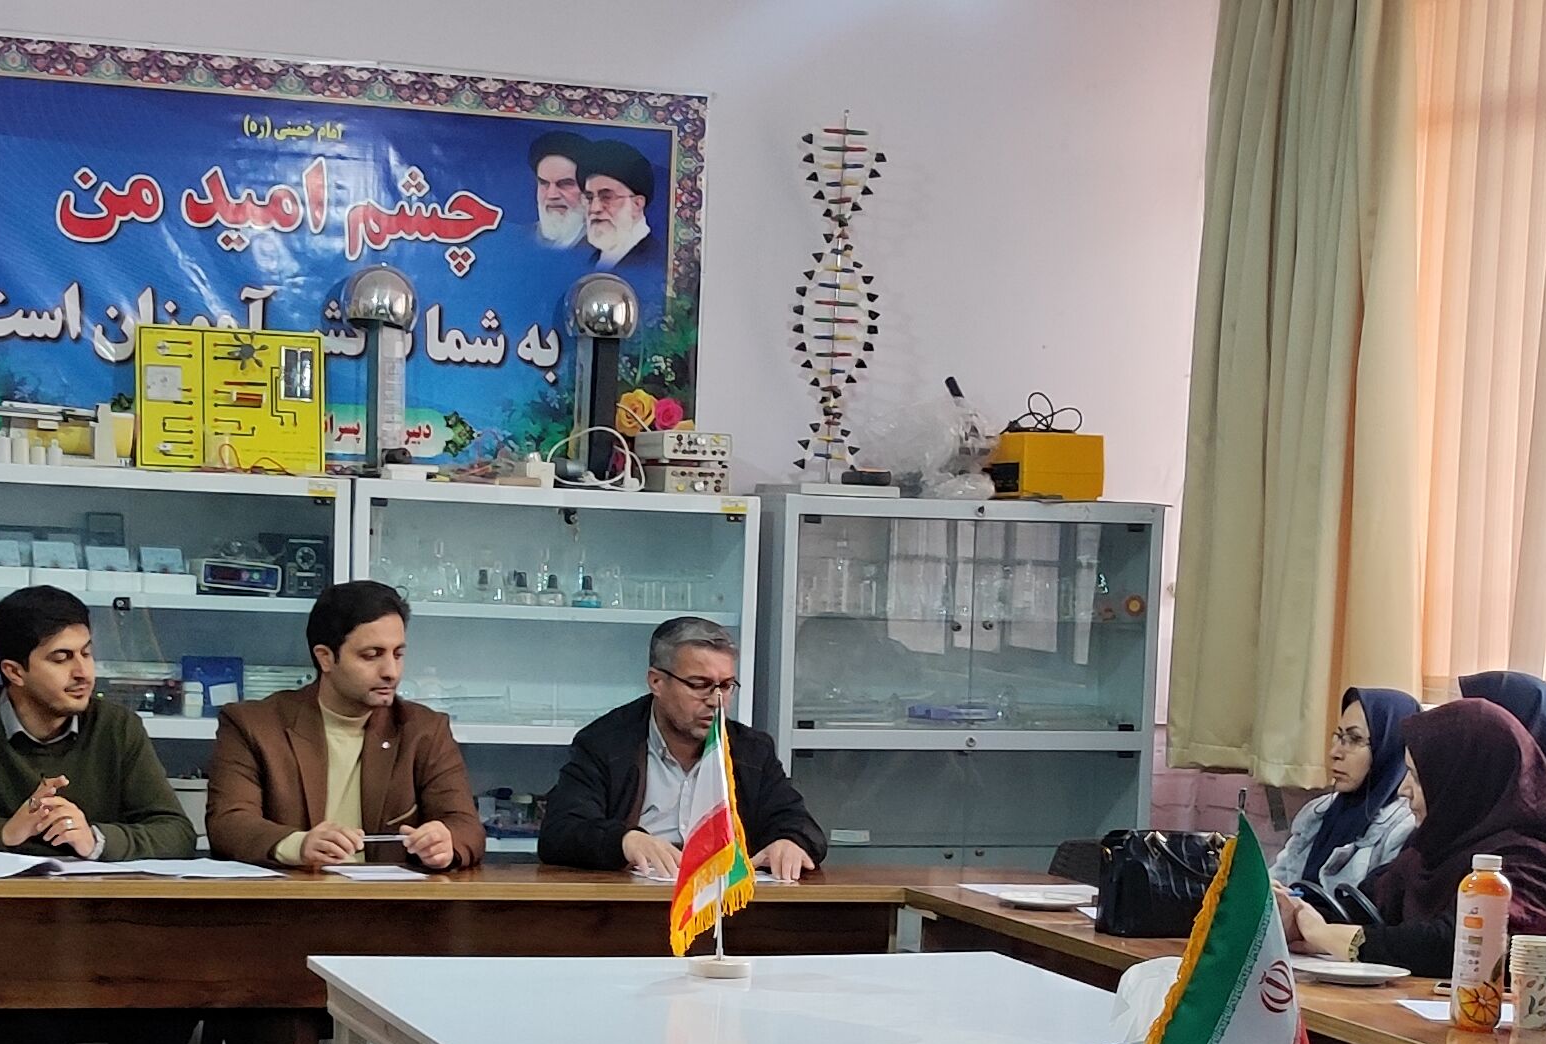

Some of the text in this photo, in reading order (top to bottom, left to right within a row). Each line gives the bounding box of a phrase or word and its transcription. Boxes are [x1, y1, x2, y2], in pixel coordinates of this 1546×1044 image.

[274, 120, 314, 140] خمینی
[317, 121, 343, 142] امام
[56, 156, 502, 276] چشم امید من
[425, 303, 504, 364] شما
[517, 323, 559, 384] به
